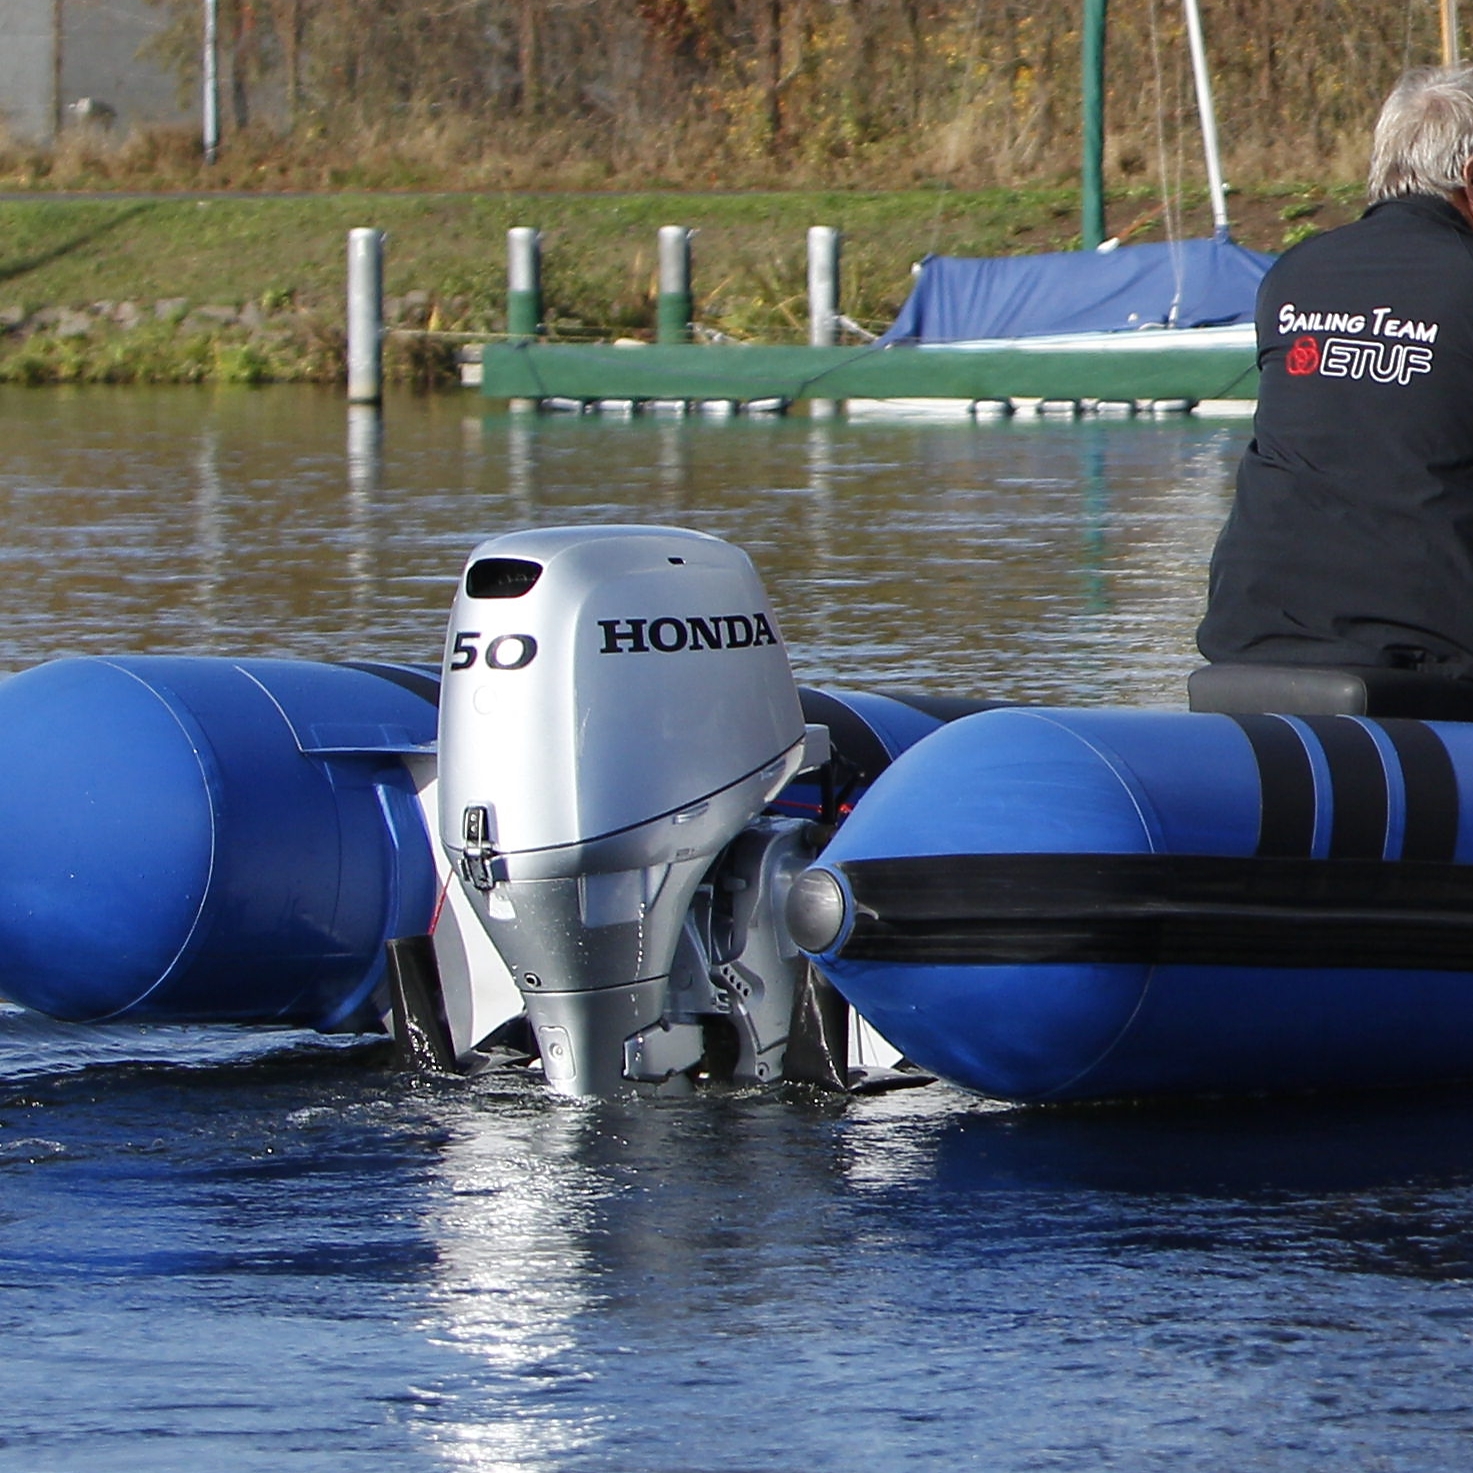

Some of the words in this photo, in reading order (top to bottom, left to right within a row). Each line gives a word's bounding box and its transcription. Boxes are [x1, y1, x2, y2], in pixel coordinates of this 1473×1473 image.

[1319, 338, 1434, 386] ETUF
[450, 631, 538, 671] 50
[597, 612, 778, 654] HONDA
